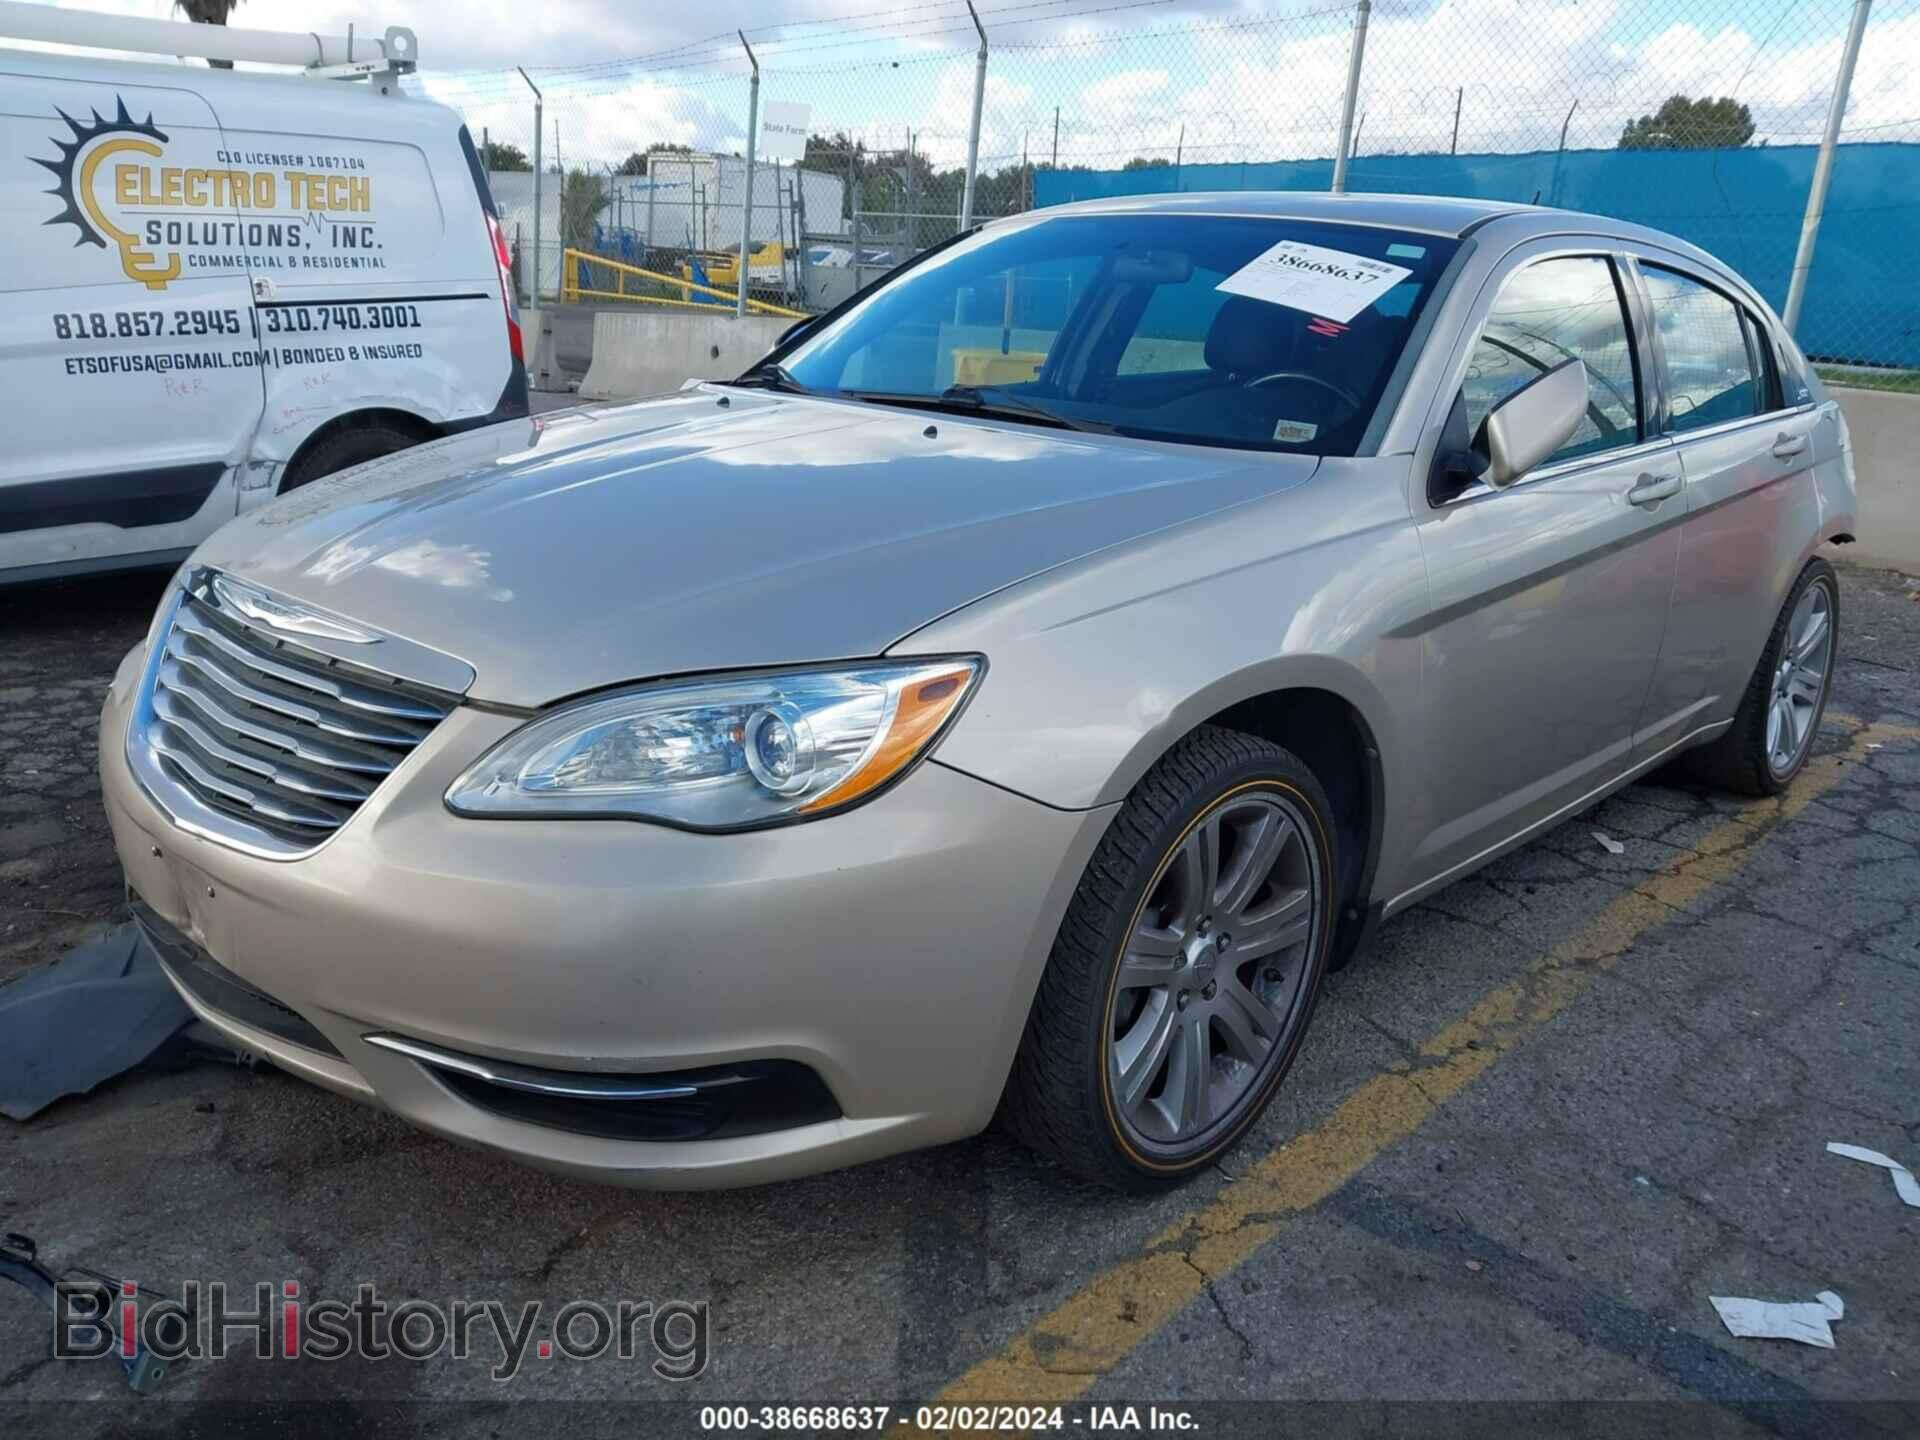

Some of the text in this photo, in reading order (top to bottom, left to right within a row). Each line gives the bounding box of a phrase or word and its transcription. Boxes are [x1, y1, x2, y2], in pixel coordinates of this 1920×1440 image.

[217, 150, 242, 163] C10
[245, 152, 304, 166] LICENSE#
[115, 163, 371, 213] ELECTRO TECH
[146, 220, 383, 250] SOLUTIONS, INC.
[188, 253, 283, 268] COMMERCIAL
[303, 257, 387, 269] RESIDENTIAL
[1268, 253, 1379, 285] 38668637
[53, 309, 240, 340] 818.857.2945
[265, 305, 422, 333] 310.740.3001
[282, 348, 345, 365] BONDED
[363, 343, 422, 360] INSURED
